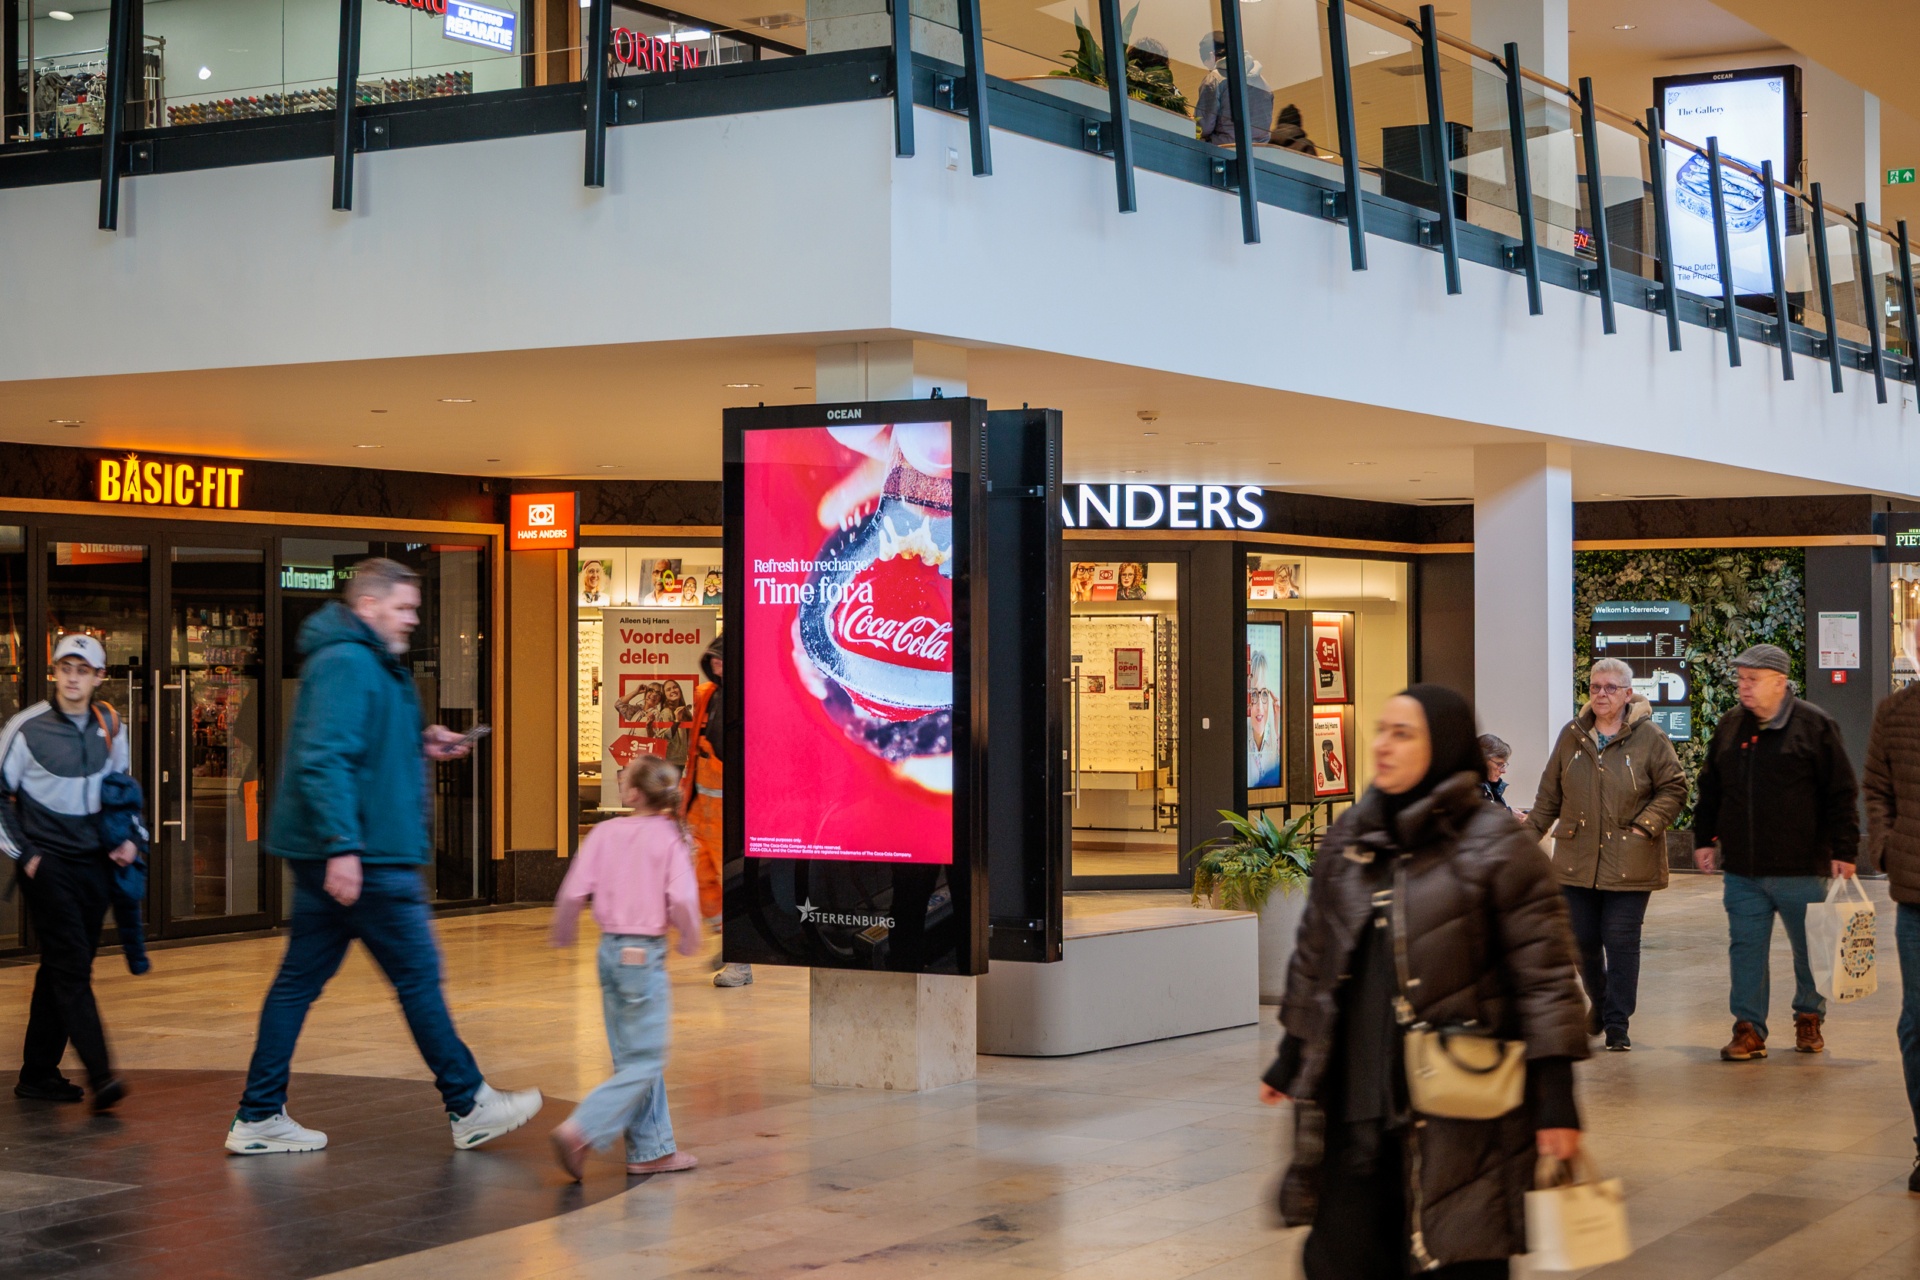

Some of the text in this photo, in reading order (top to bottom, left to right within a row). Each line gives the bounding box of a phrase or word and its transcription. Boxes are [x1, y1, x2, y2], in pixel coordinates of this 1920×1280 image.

[446, 15, 513, 46] REPARATIE
[611, 27, 699, 72] ORREN
[1677, 106, 1724, 116] The Gallery
[1694, 263, 1716, 271] Dutch
[1677, 272, 1719, 281] Tile Project
[827, 408, 862, 420] OCEAN
[517, 529, 568, 539] HANS ANDERS
[754, 559, 799, 573] Refresh
[800, 560, 812, 572] to
[754, 576, 874, 604] Time for a
[1630, 606, 1669, 614] Sterrenburg
[642, 617, 651, 625] bij
[1679, 624, 1685, 632] 1
[619, 628, 700, 644] Voordeel
[619, 648, 669, 664] delen
[808, 912, 896, 928] STERRENBURG
[1852, 938, 1875, 948] ACTION
